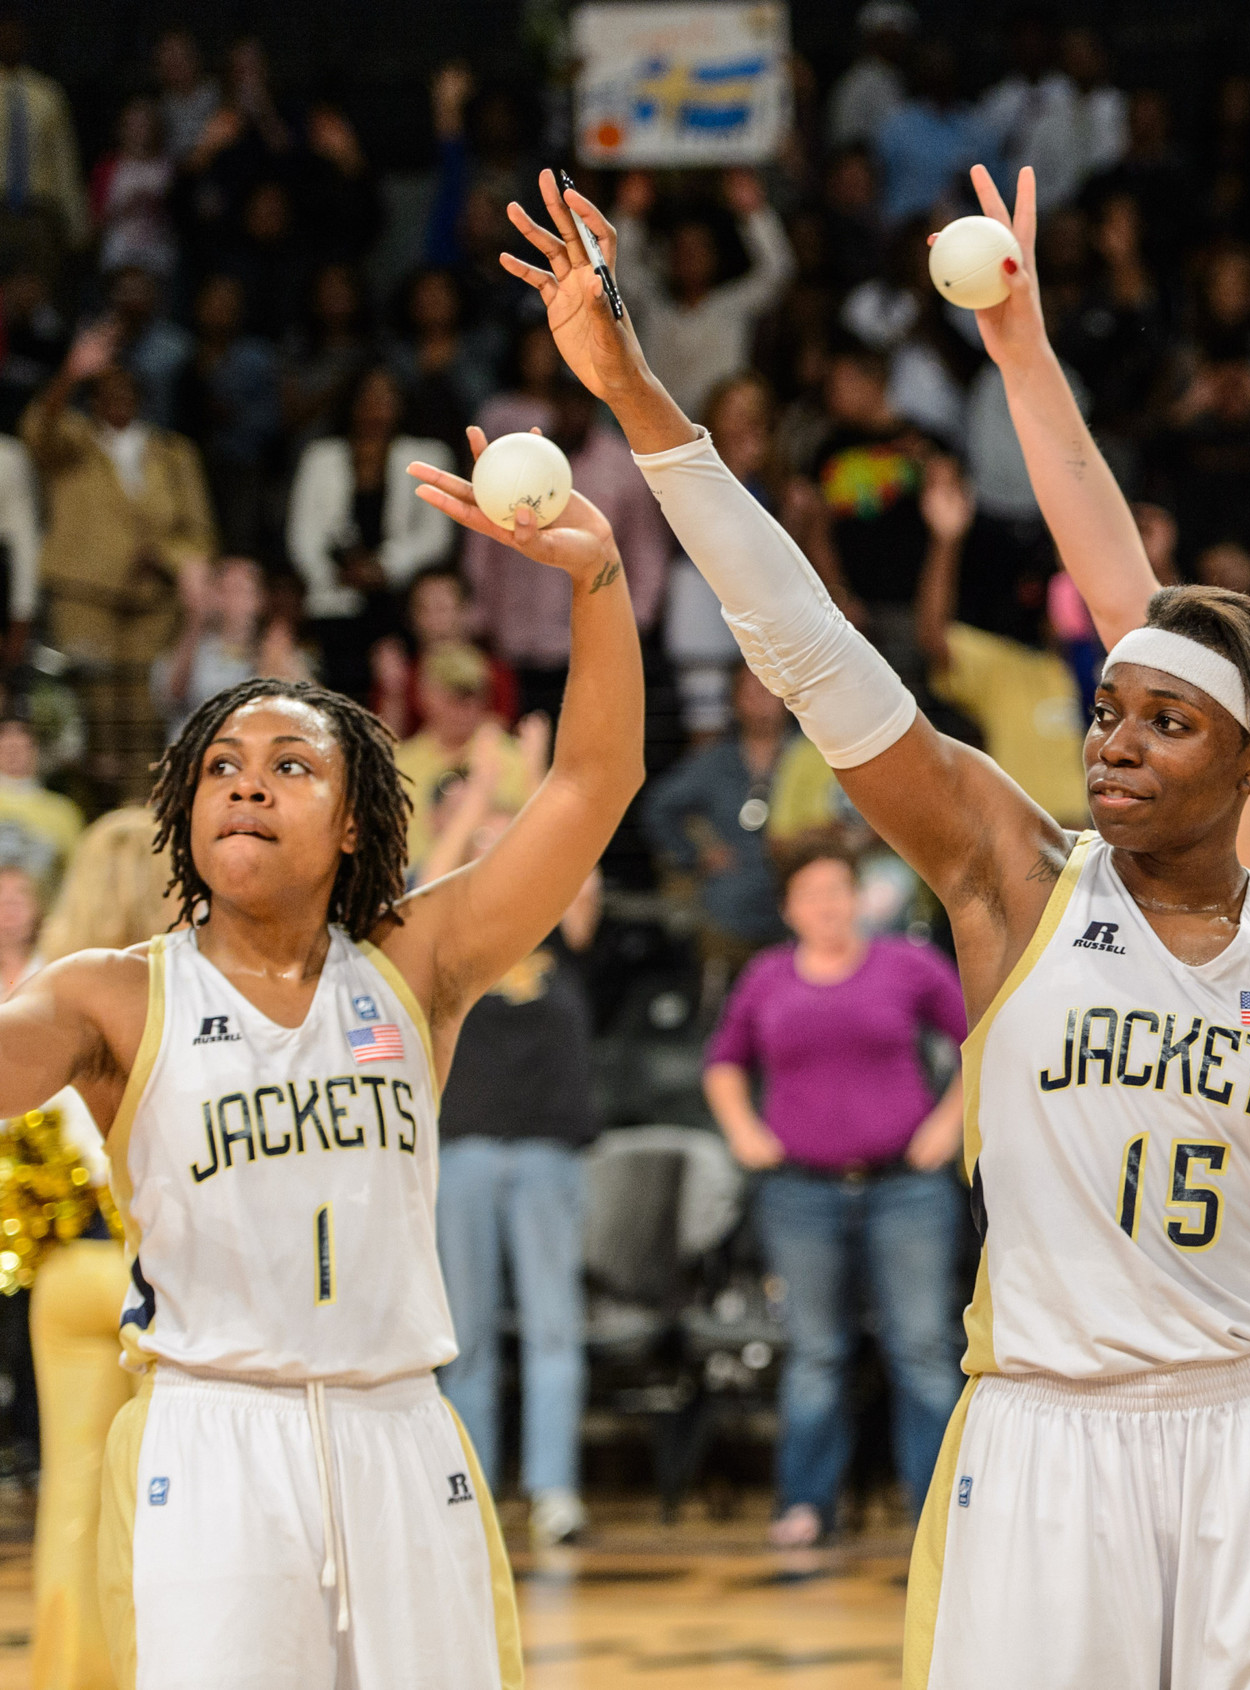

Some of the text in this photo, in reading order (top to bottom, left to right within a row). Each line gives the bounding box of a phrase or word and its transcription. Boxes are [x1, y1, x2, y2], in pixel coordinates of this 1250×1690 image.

[1081, 921, 1119, 944] R
[1072, 939, 1126, 955] RUSSELL
[200, 1016, 230, 1036] R
[192, 1033, 242, 1046] RUSSELL
[190, 1074, 417, 1185] JACKETS
[1115, 1131, 1231, 1253] 15
[313, 1200, 337, 1308] 1
